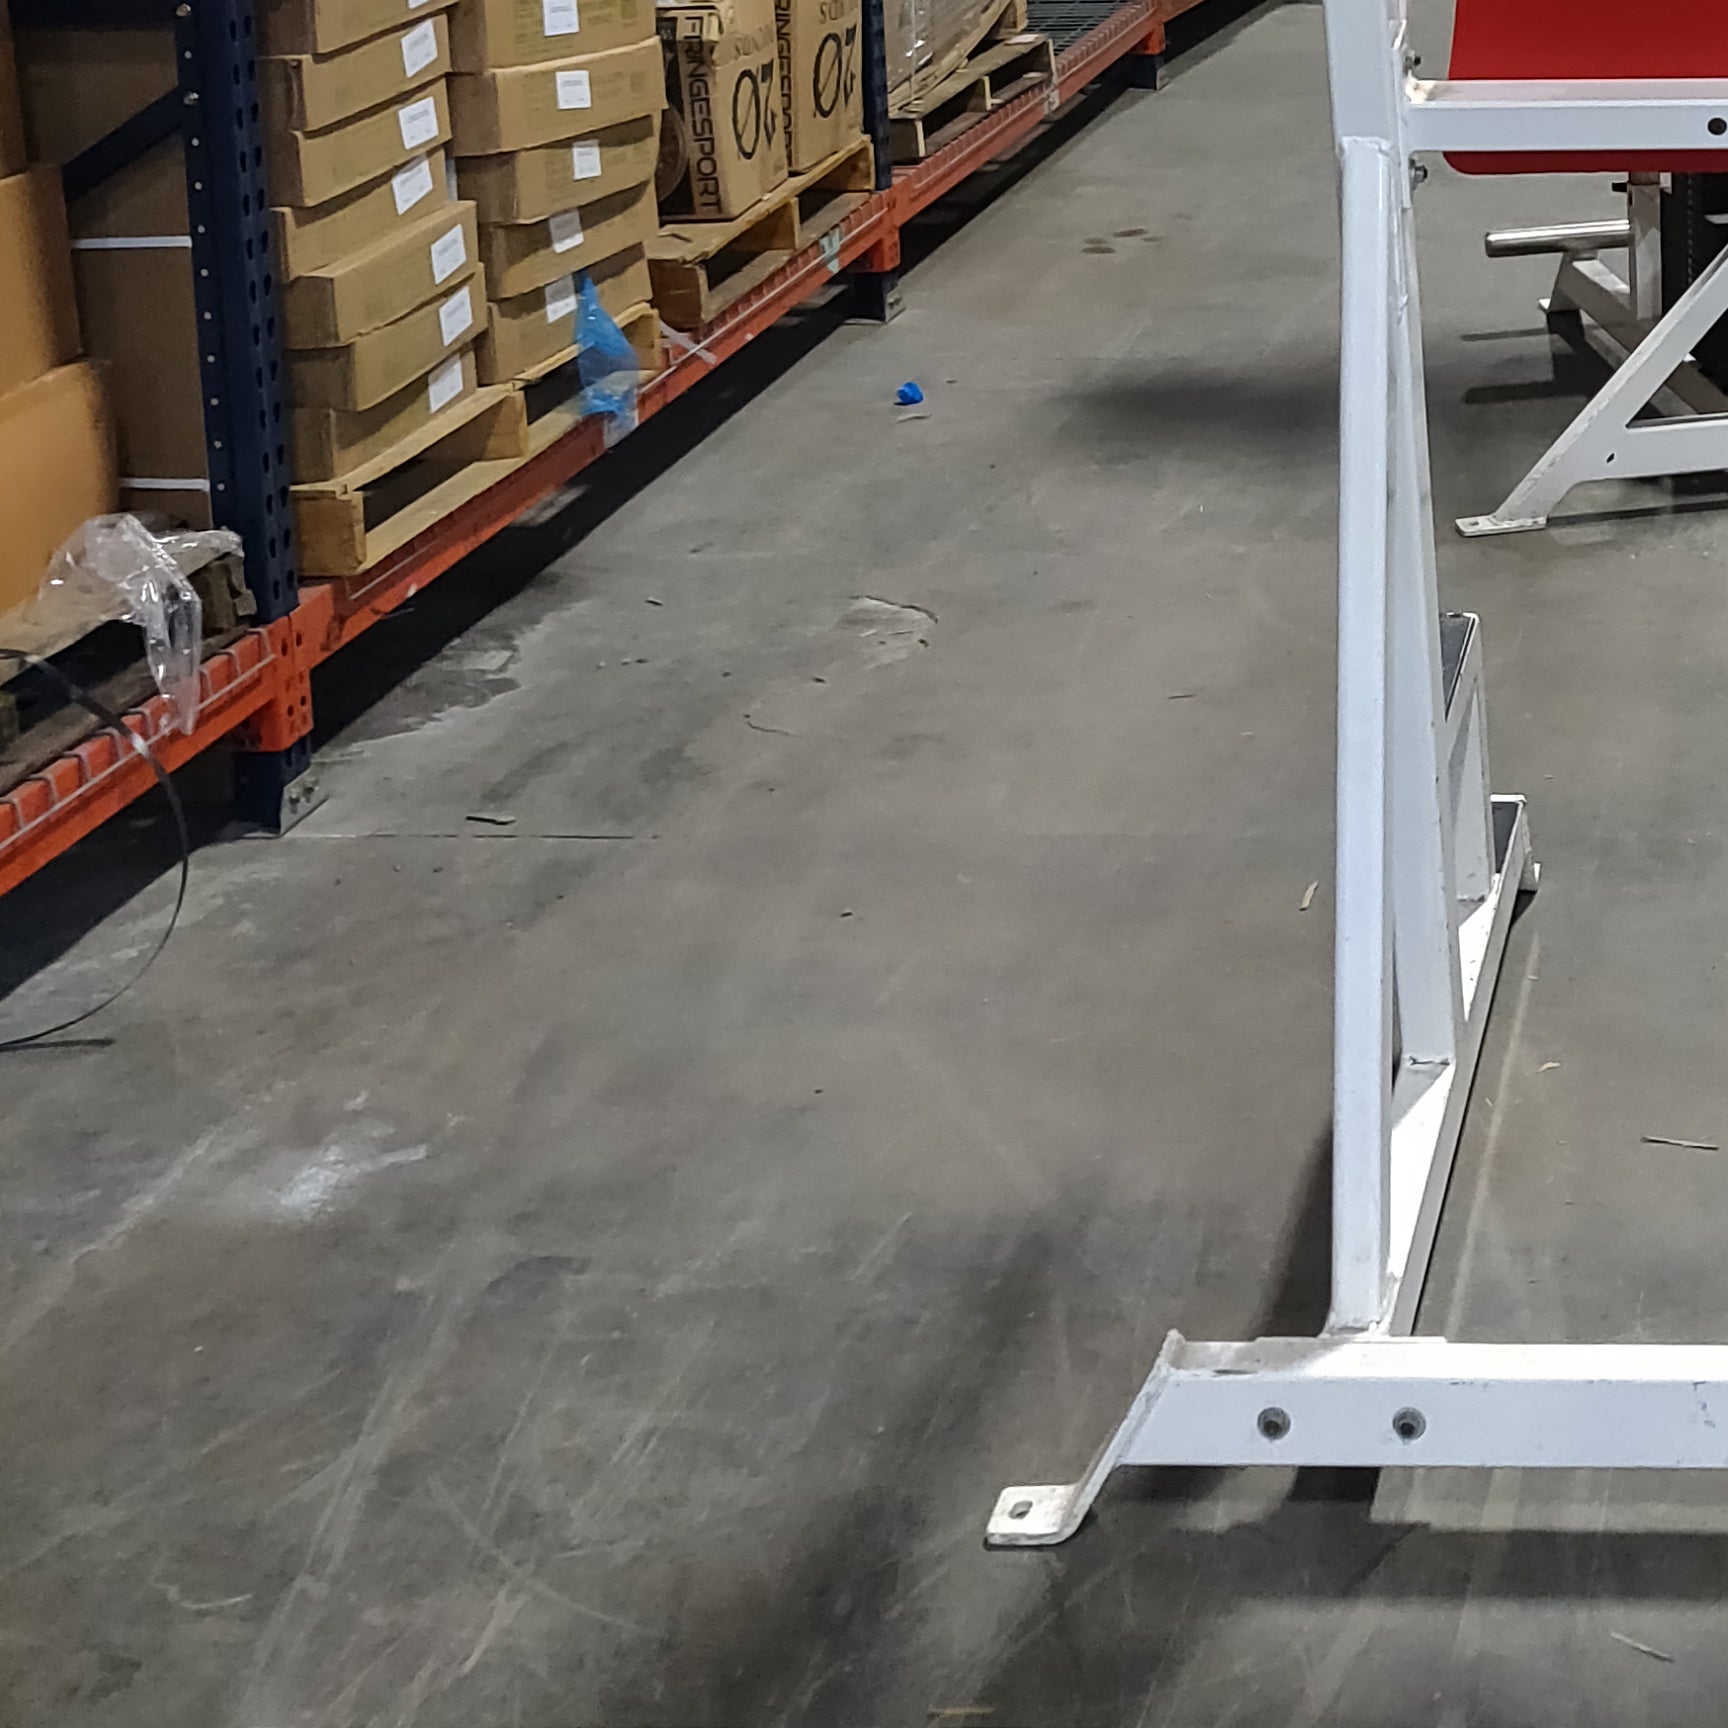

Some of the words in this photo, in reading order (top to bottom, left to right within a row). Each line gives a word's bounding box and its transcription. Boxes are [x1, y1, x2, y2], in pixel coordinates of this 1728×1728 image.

[683, 16, 722, 214] FRINGESPORT
[732, 58, 778, 161] 20
[812, 22, 858, 119] 20
